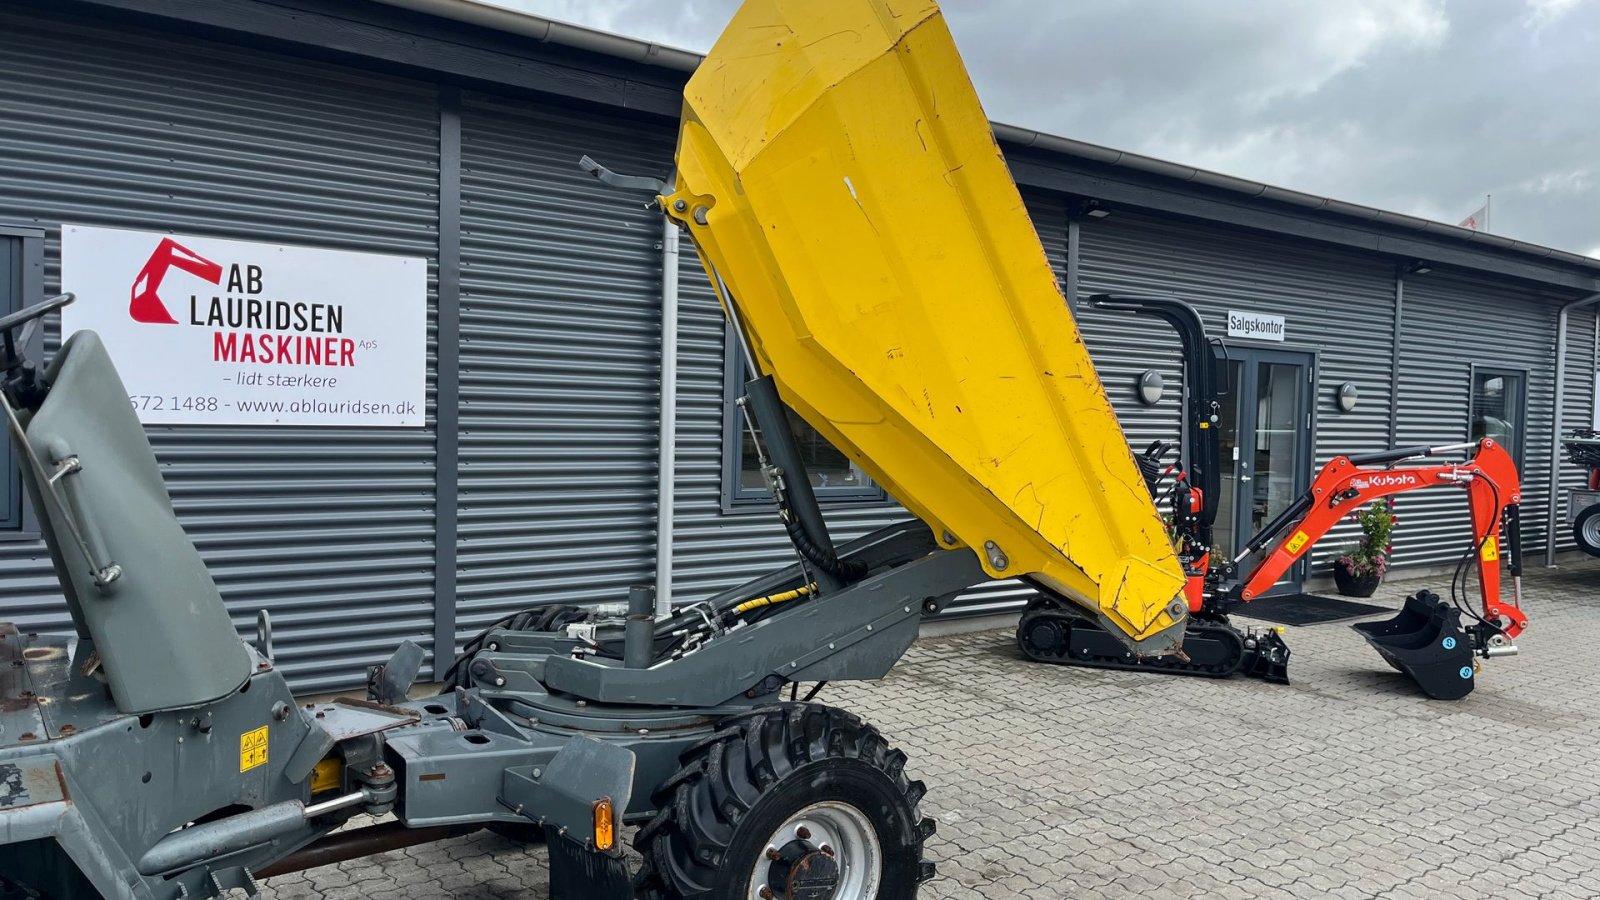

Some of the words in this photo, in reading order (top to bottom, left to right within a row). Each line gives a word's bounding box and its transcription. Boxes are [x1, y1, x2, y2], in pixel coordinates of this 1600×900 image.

[226, 263, 263, 295] AB
[190, 295, 343, 334] LAURIDSEN
[1230, 315, 1283, 335] Salgskontor
[213, 331, 355, 367] MASKINER
[358, 339, 378, 351] ApS
[236, 371, 263, 386] lidt
[266, 373, 337, 388] stærkere
[169, 396, 218, 412] 1488
[236, 398, 416, 415] www.ablauridsen.dk
[1369, 474, 1416, 486] Kubota
